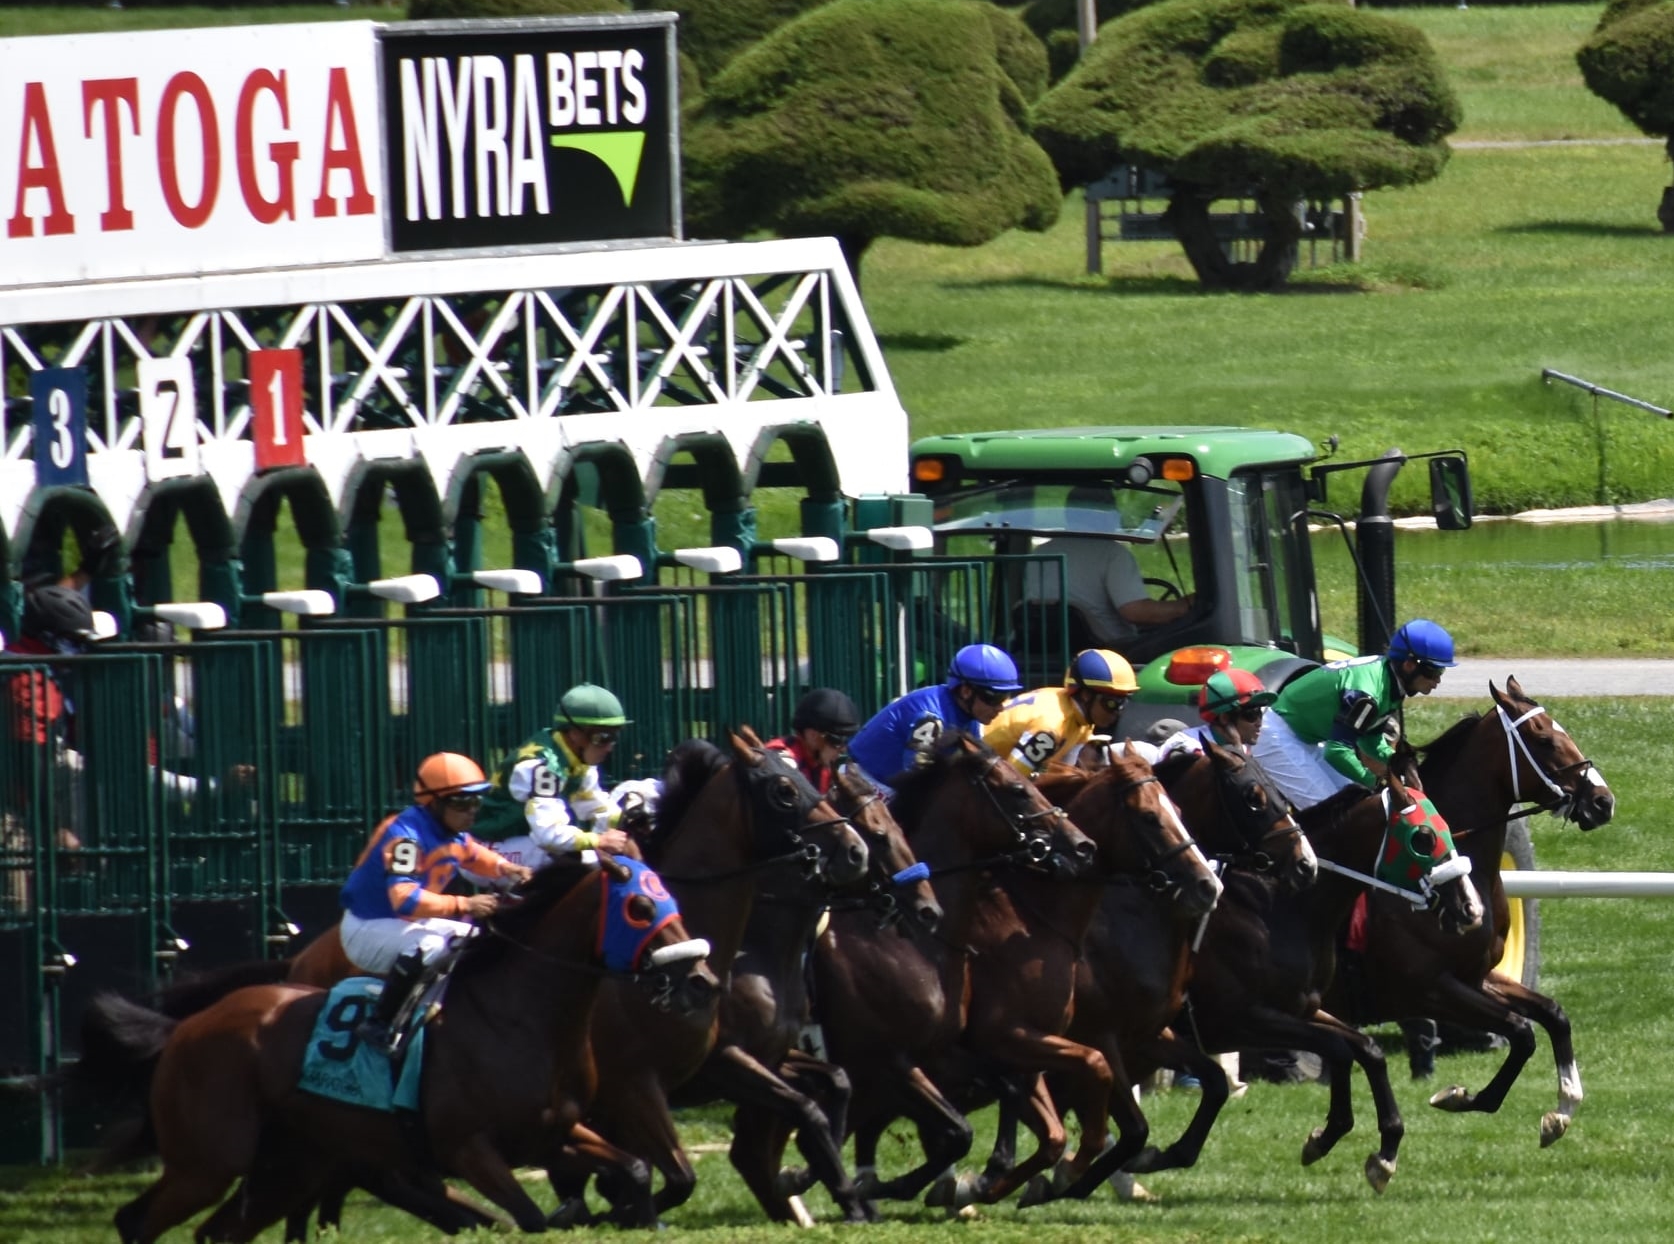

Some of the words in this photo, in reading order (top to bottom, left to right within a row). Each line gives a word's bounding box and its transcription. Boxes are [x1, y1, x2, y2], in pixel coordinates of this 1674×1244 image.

[7, 67, 376, 238] ATOGA
[400, 53, 551, 221] NYRA
[547, 48, 648, 127] BETS
[48, 388, 74, 469] 3
[155, 380, 186, 459] 2
[267, 369, 288, 446] 1
[912, 721, 936, 746] 4
[1025, 732, 1055, 762] 3
[1354, 702, 1373, 729] 1
[534, 763, 558, 797] 8
[391, 842, 418, 874] 9
[317, 995, 363, 1062] 9
